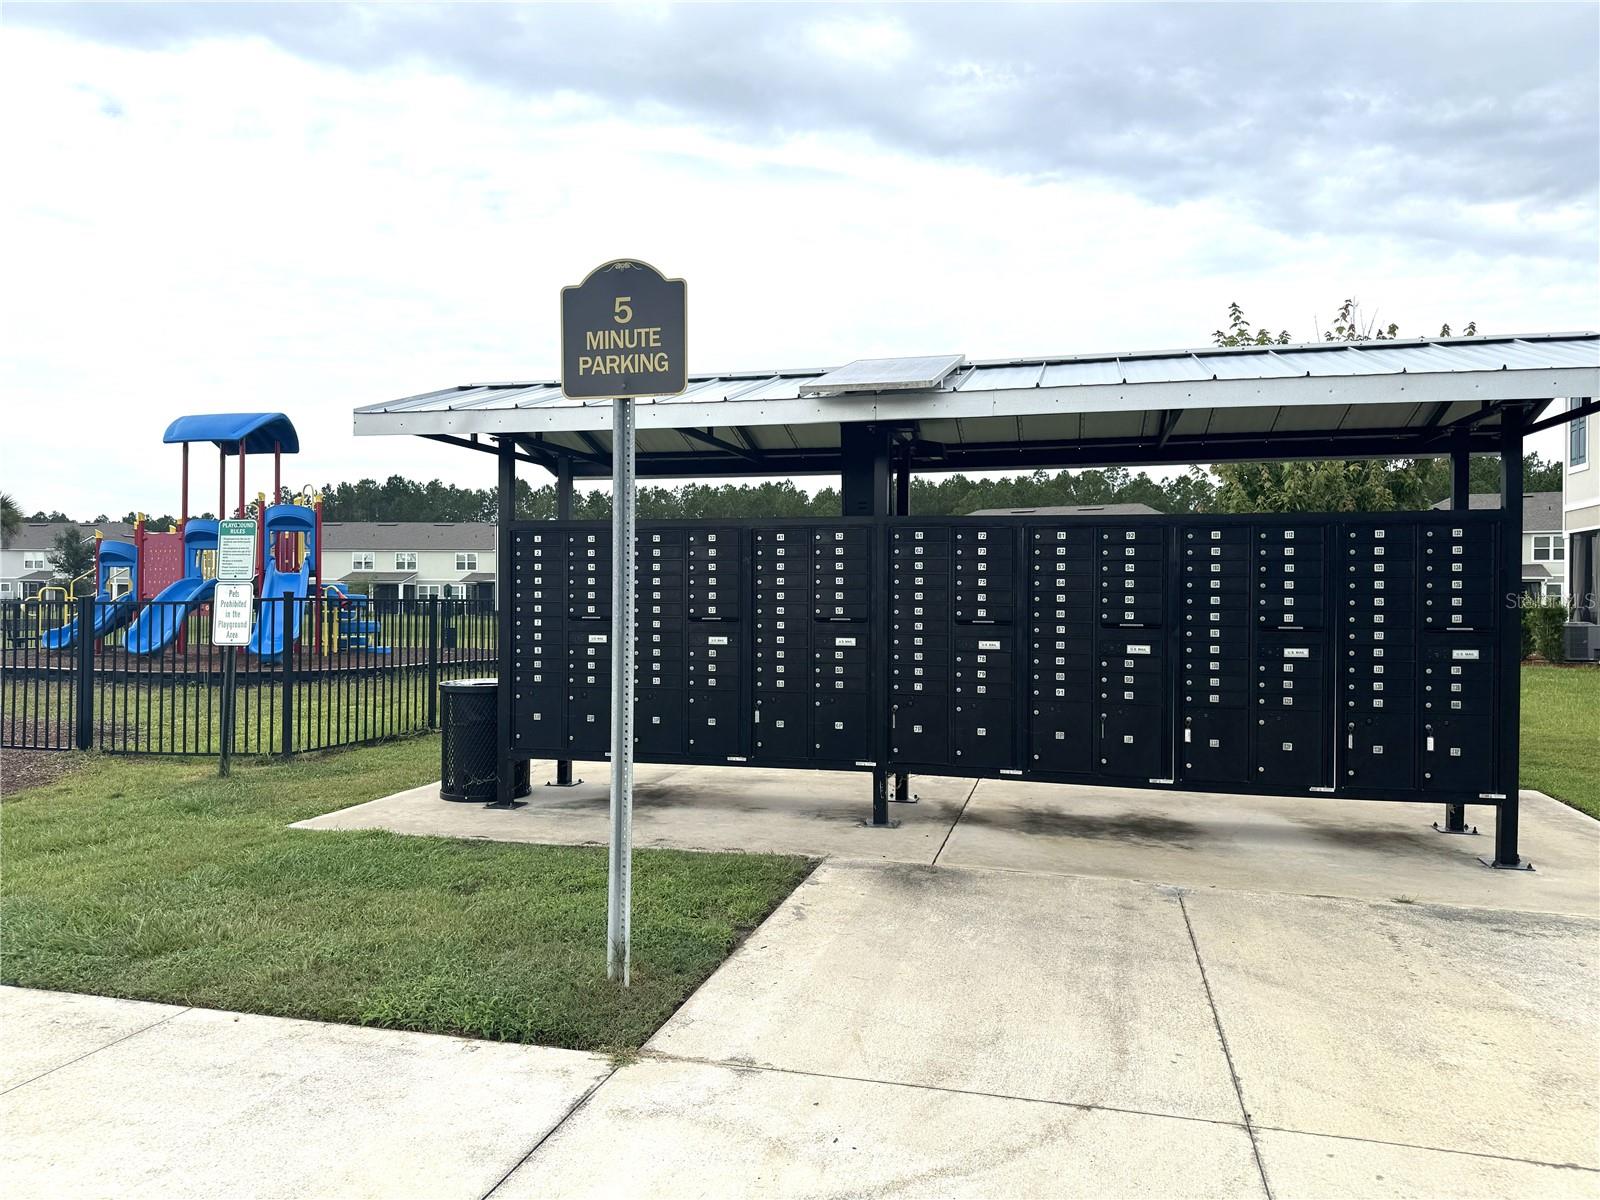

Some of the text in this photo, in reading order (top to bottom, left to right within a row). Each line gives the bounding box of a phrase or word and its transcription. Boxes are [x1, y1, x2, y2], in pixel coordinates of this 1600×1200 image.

[614, 296, 633, 324] 5
[586, 327, 662, 351] MINUTE
[579, 352, 669, 376] PARKING
[229, 589, 240, 597] Pets
[220, 599, 247, 608] Prohibited
[232, 609, 241, 617] the
[218, 620, 248, 629] Playground
[226, 630, 239, 638] Area
